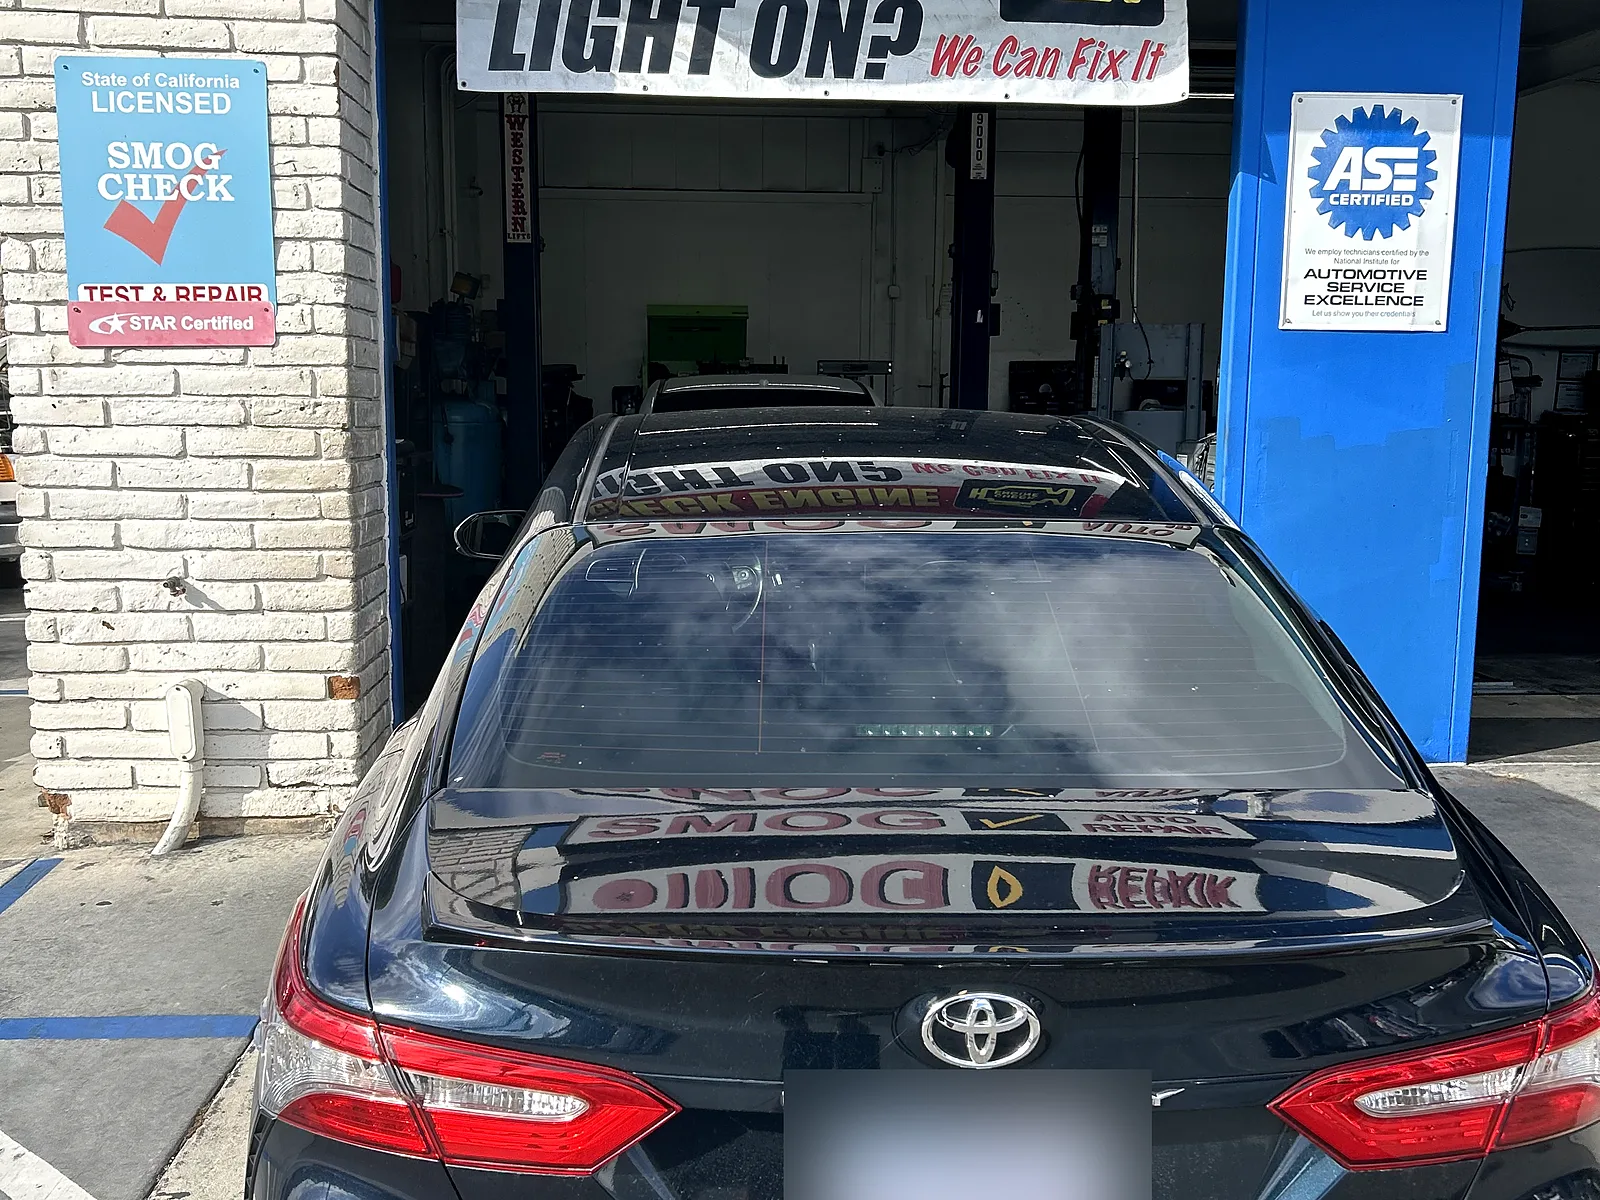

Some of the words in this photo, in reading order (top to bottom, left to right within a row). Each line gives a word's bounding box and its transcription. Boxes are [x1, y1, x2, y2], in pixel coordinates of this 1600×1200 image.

[488, 0, 735, 76] LIGHT
[749, 0, 923, 80] ON?
[930, 34, 983, 78] We
[992, 35, 1062, 79] Can
[1067, 36, 1129, 81] Fix
[1130, 39, 1168, 82] It
[81, 72, 128, 87] State
[132, 73, 151, 87] of
[154, 73, 240, 89] California
[92, 91, 232, 114] LICENSED
[976, 114, 984, 161] 9000
[107, 142, 222, 170] SMOG
[504, 114, 529, 233] WESTERN
[1322, 146, 1419, 192] ASE
[97, 173, 235, 201] CHECK
[1329, 192, 1414, 206] CERTIFIED
[1318, 248, 1342, 257] employ
[1343, 248, 1380, 256] technicians
[1409, 249, 1418, 258] by
[1419, 249, 1430, 257] the
[1333, 257, 1361, 265] National
[1363, 257, 1389, 265] Institute
[1303, 268, 1427, 281] AUTOMOTIVE
[1326, 281, 1405, 293] SERVICE
[1303, 295, 1425, 306] EXCELLENCE
[1312, 309, 1323, 317] Let
[1379, 310, 1416, 318] credentials
[129, 315, 177, 330] STAR
[180, 316, 254, 331] Certified
[588, 810, 948, 838] SMOG
[1093, 813, 1197, 825] AUTO
[1082, 823, 1232, 836] REPAIR
